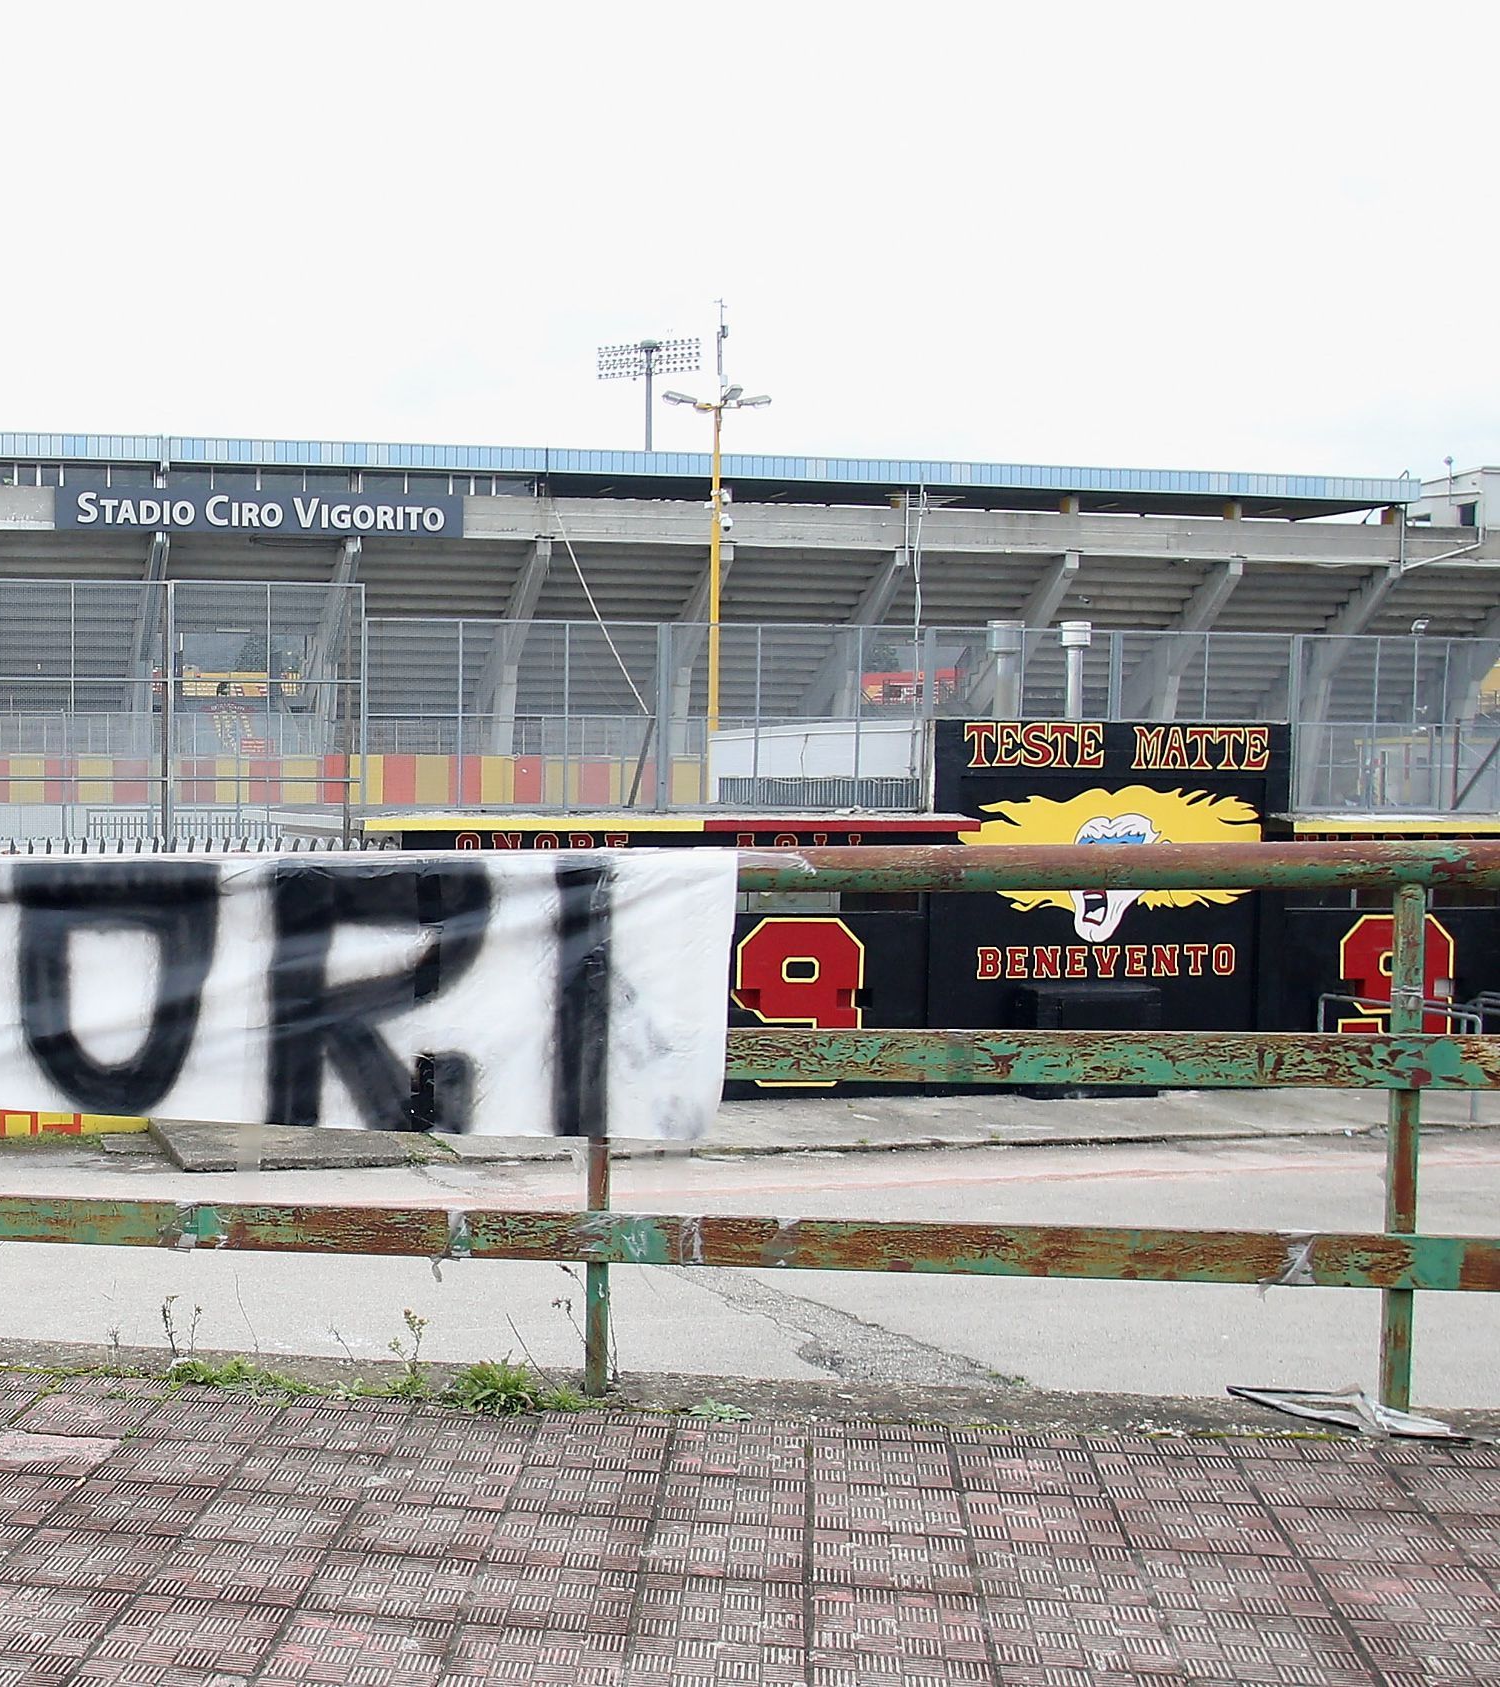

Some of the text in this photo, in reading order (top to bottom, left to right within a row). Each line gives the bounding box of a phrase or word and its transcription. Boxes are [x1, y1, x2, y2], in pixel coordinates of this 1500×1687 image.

[76, 492, 446, 532] STADIO CIRO VIGORITO
[963, 723, 1270, 771] TESTE MATTE
[976, 942, 1236, 981] BENEVENTO
